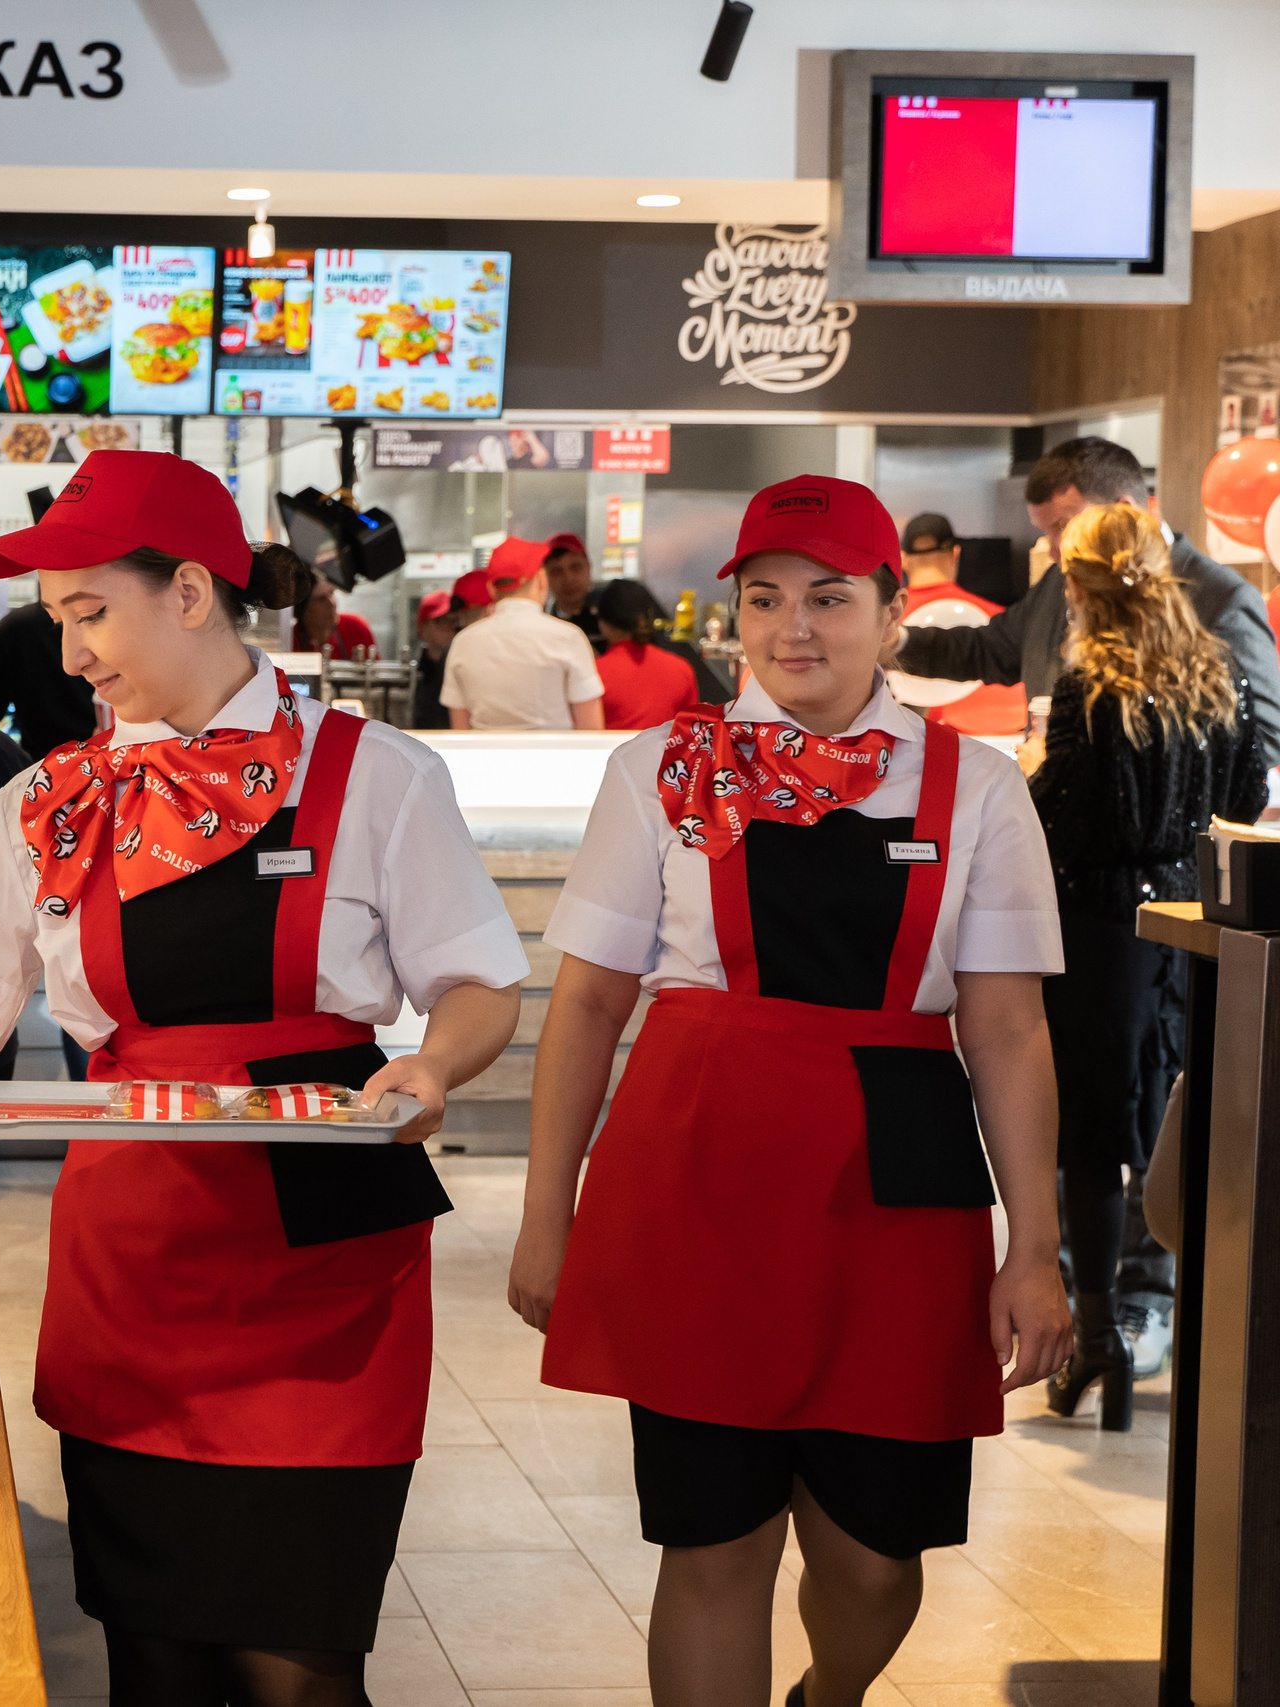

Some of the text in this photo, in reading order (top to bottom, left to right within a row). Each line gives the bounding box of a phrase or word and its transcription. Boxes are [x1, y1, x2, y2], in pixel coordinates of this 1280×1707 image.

[704, 223, 829, 290] Savour
[724, 267, 828, 325] Every
[965, 277, 1069, 300] ВЫДАЧА
[678, 301, 857, 370] Moment
[771, 496, 823, 511] ROSTIC'S
[817, 743, 871, 764] ROSTIC'S
[170, 770, 228, 785] ROSTIC'S
[150, 844, 206, 874] OSTIC'S
[893, 846, 931, 854] Татьяна
[266, 857, 296, 867] Ирина
